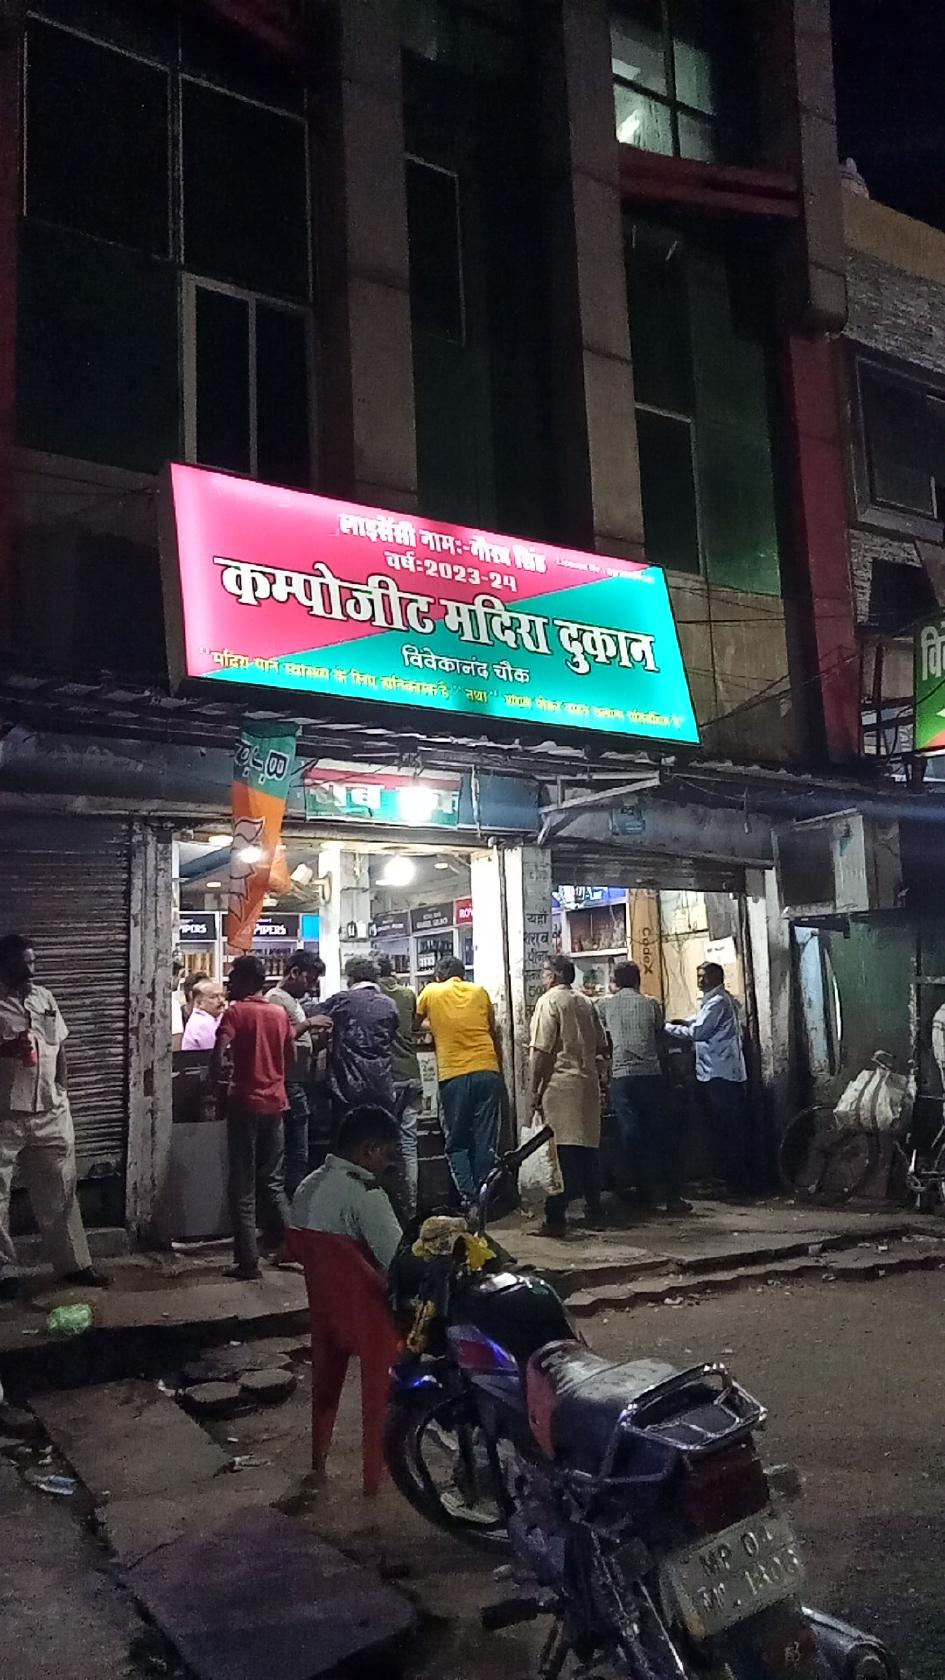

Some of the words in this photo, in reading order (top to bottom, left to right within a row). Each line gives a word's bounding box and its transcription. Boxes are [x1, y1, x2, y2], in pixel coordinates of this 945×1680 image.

[213, 556, 435, 635] कम्पोजीट
[439, 593, 552, 656] मदिरा
[553, 618, 661, 675] दुकान
[401, 644, 489, 680] विवेकानंद
[493, 660, 530, 683] चौक
